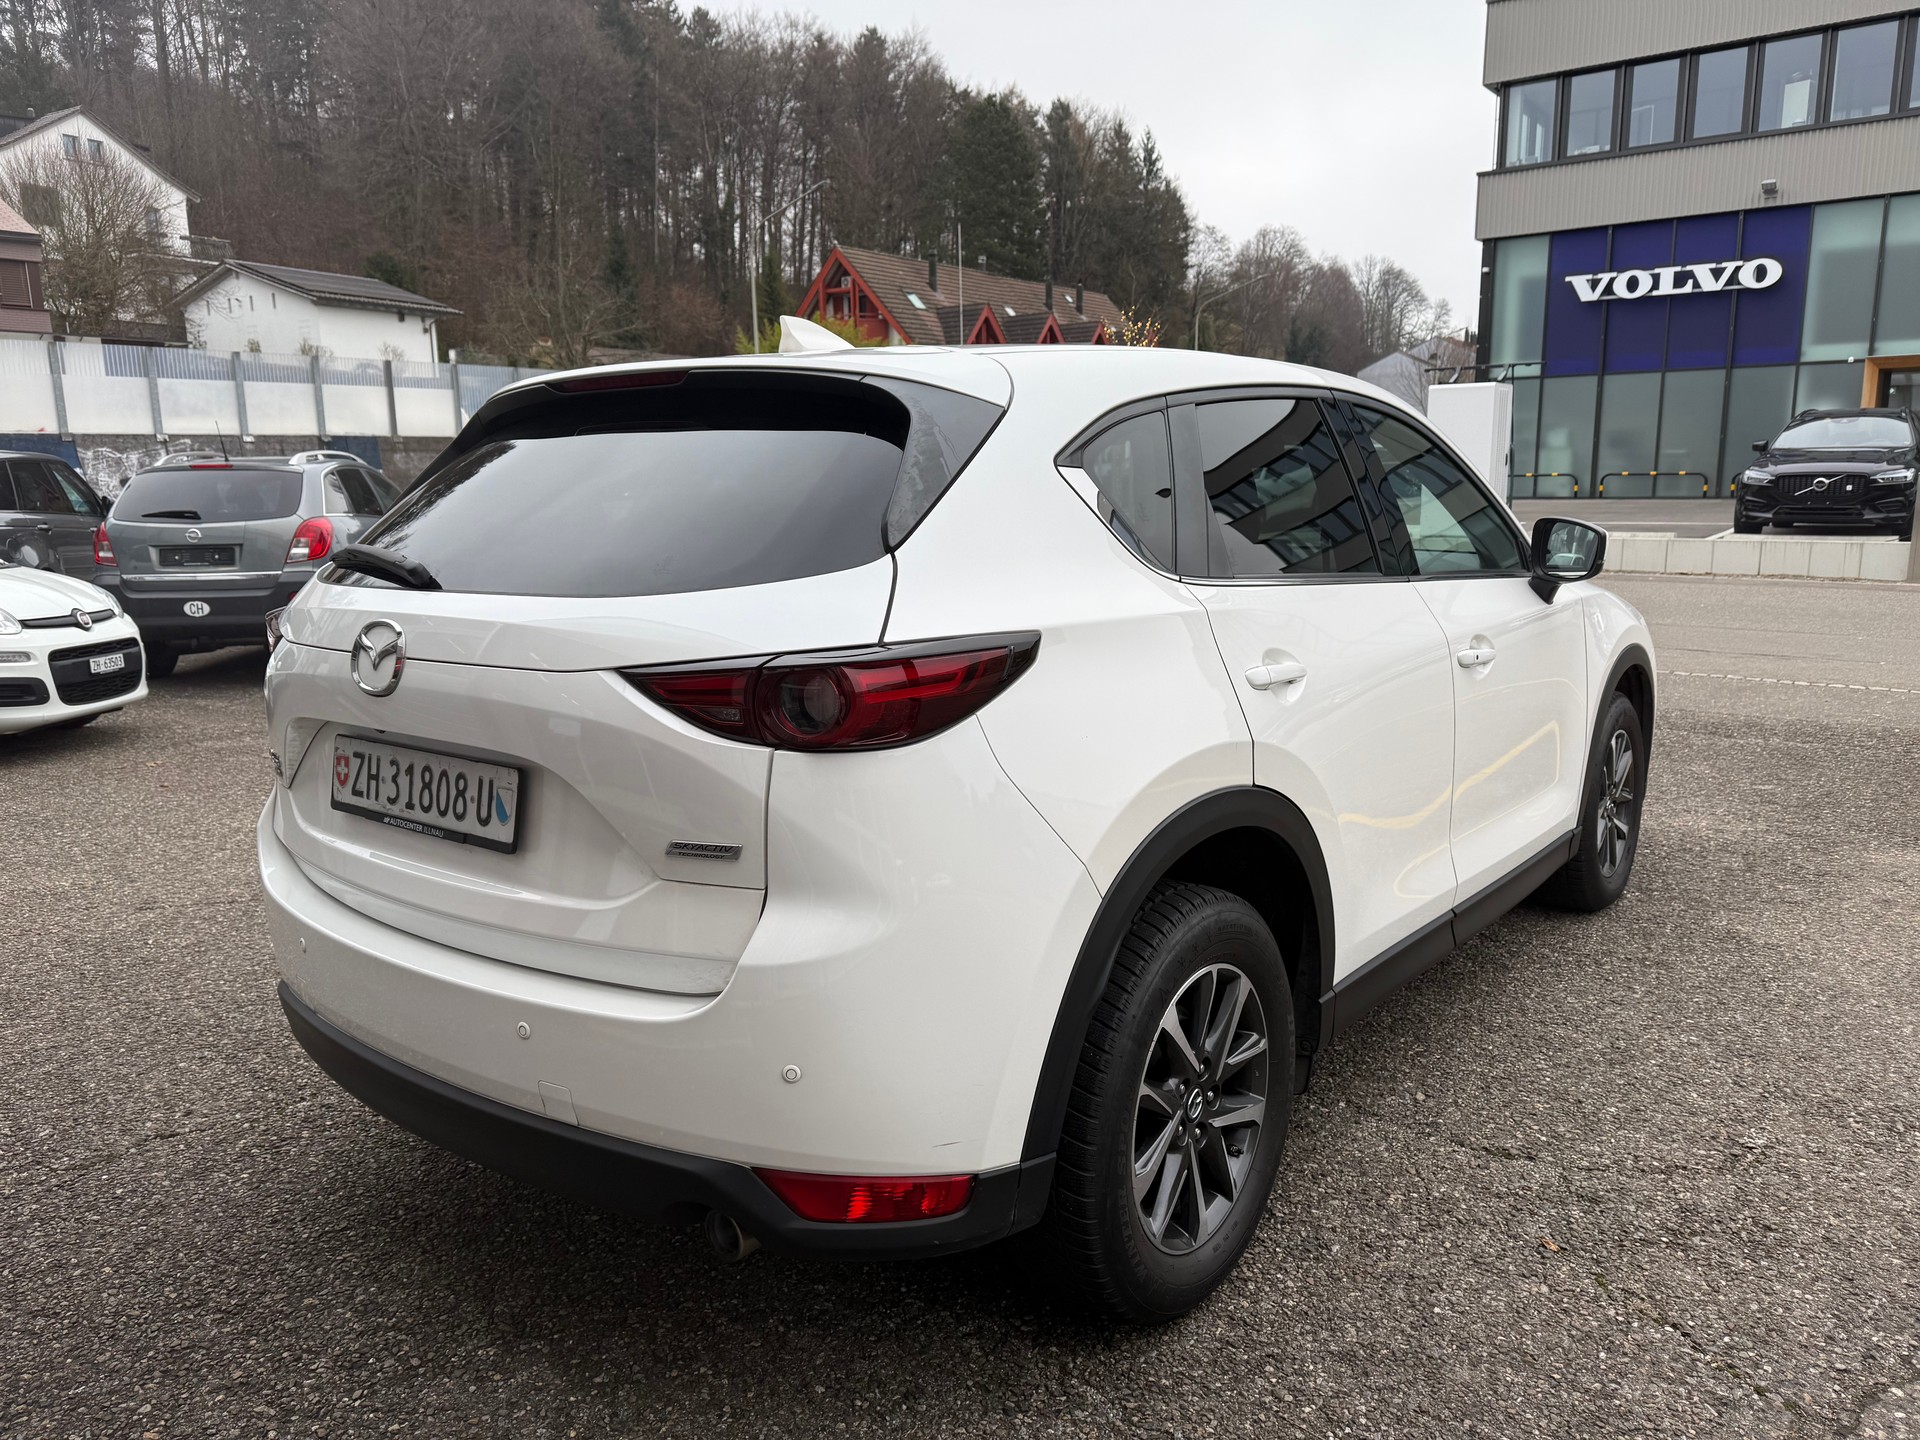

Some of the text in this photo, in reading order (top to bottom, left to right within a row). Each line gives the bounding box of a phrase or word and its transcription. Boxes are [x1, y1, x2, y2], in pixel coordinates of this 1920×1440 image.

[1565, 258, 1782, 302] VOLVO
[189, 603, 204, 615] CH
[390, 818, 444, 837] AUTOCENTER ILLNAU
[673, 843, 733, 852] SKYACTIV
